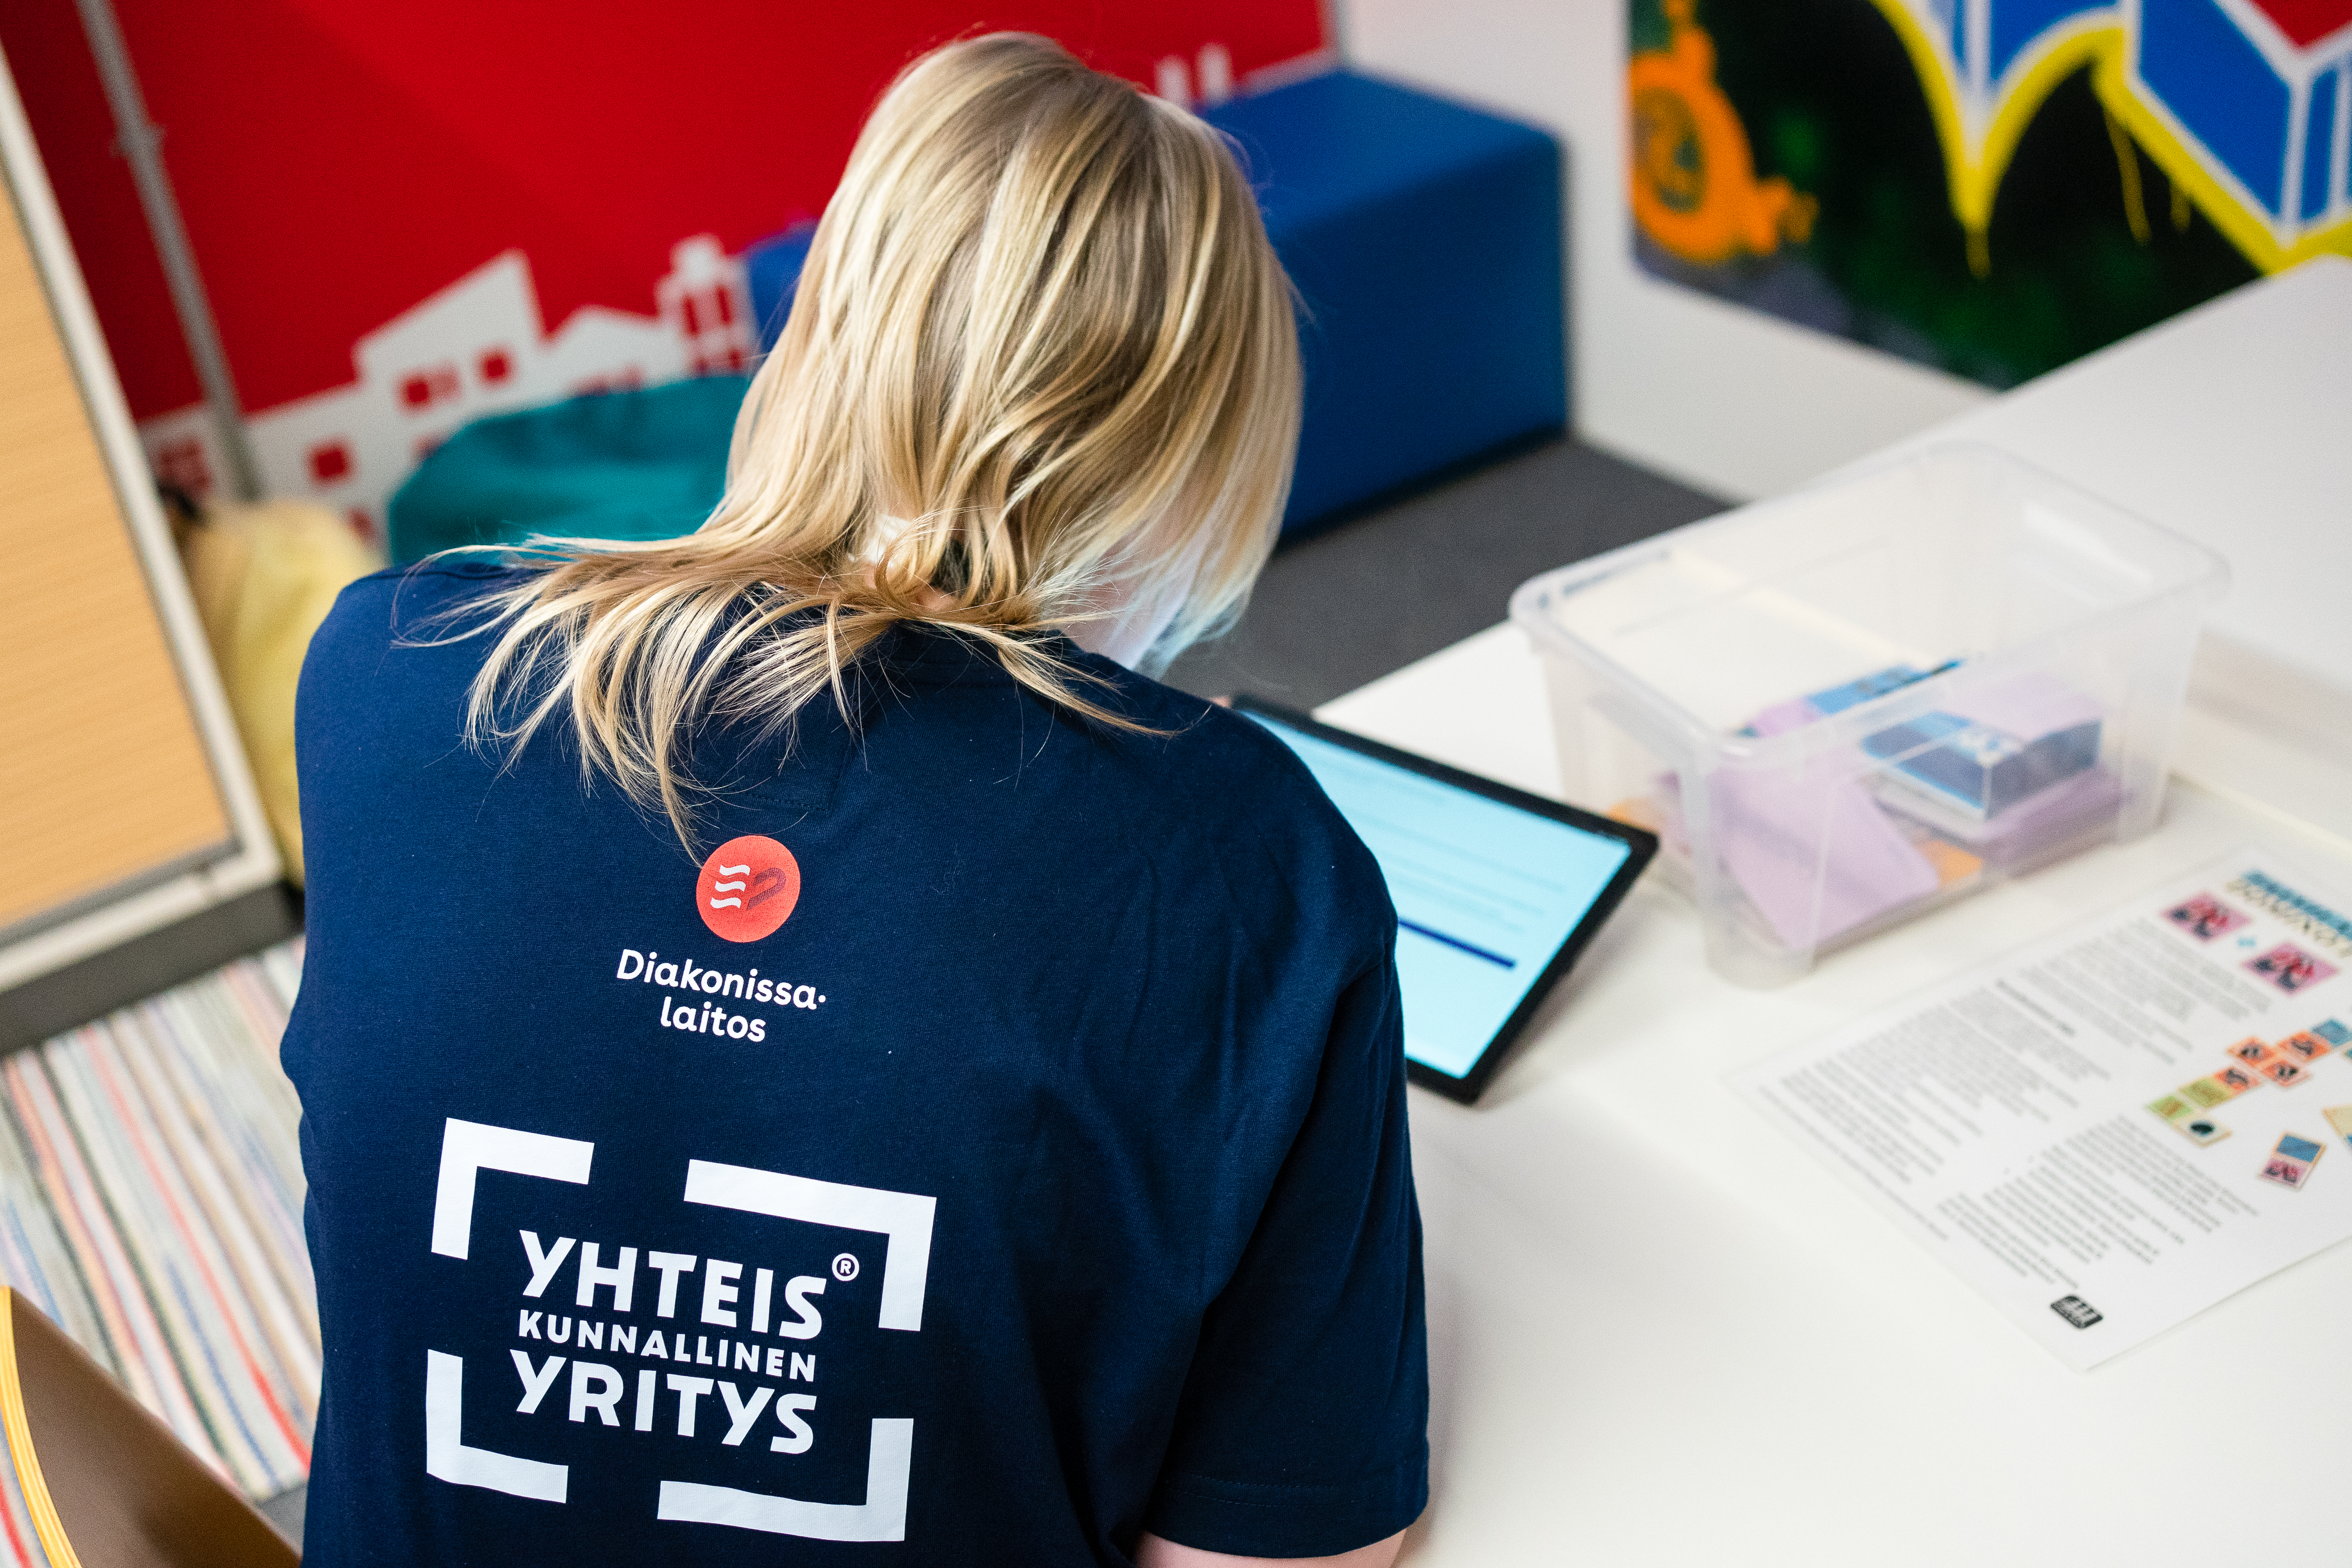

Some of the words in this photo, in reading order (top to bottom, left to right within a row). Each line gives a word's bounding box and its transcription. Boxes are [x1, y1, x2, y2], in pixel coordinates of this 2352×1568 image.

[660, 996, 766, 1042] laitos
[519, 1309, 816, 1382] KUNNALLINEN
[510, 1349, 817, 1454] YRITYS
